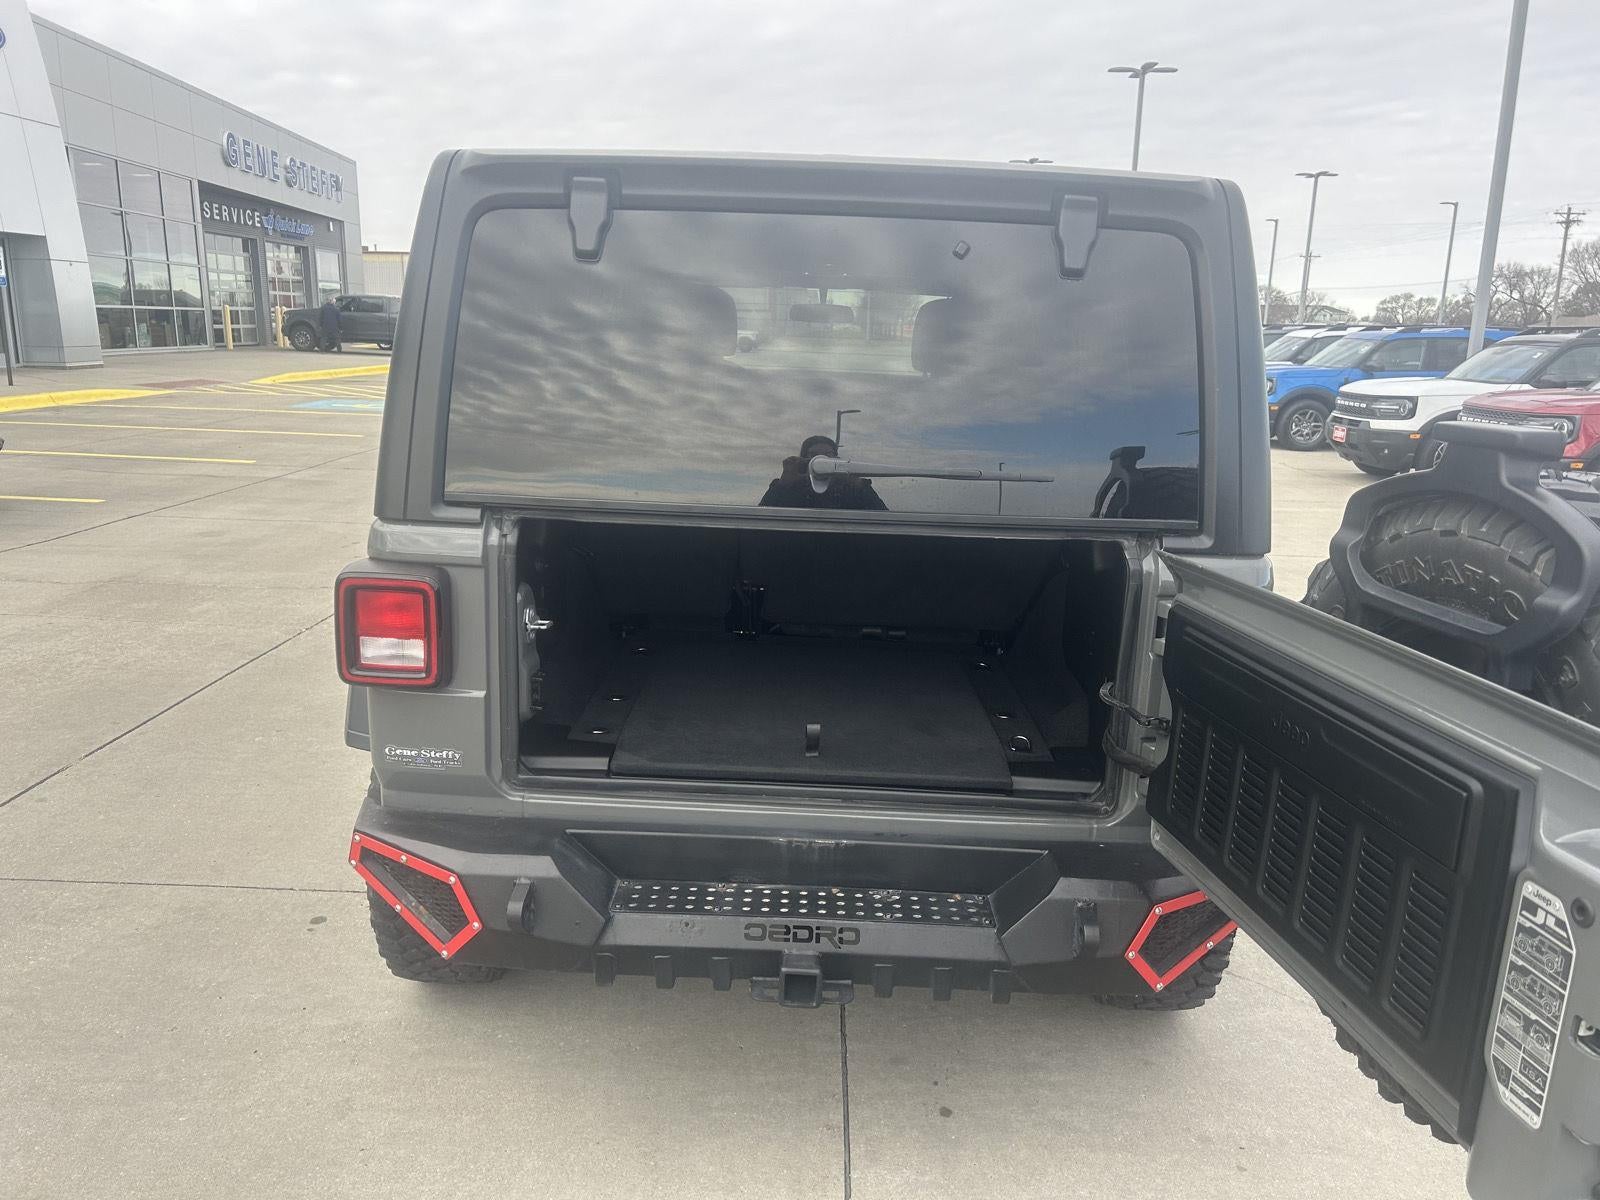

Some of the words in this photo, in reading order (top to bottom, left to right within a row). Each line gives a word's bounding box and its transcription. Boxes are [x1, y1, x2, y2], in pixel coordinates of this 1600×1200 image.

[222, 131, 280, 182] GENE
[287, 157, 344, 202] STEFFY
[203, 201, 261, 227] SERVICE
[1272, 710, 1312, 745] Jeep
[384, 746, 419, 757] Gene
[420, 749, 461, 761] Steffy
[1533, 890, 1552, 907] Jeep
[1520, 1063, 1545, 1089] USA
